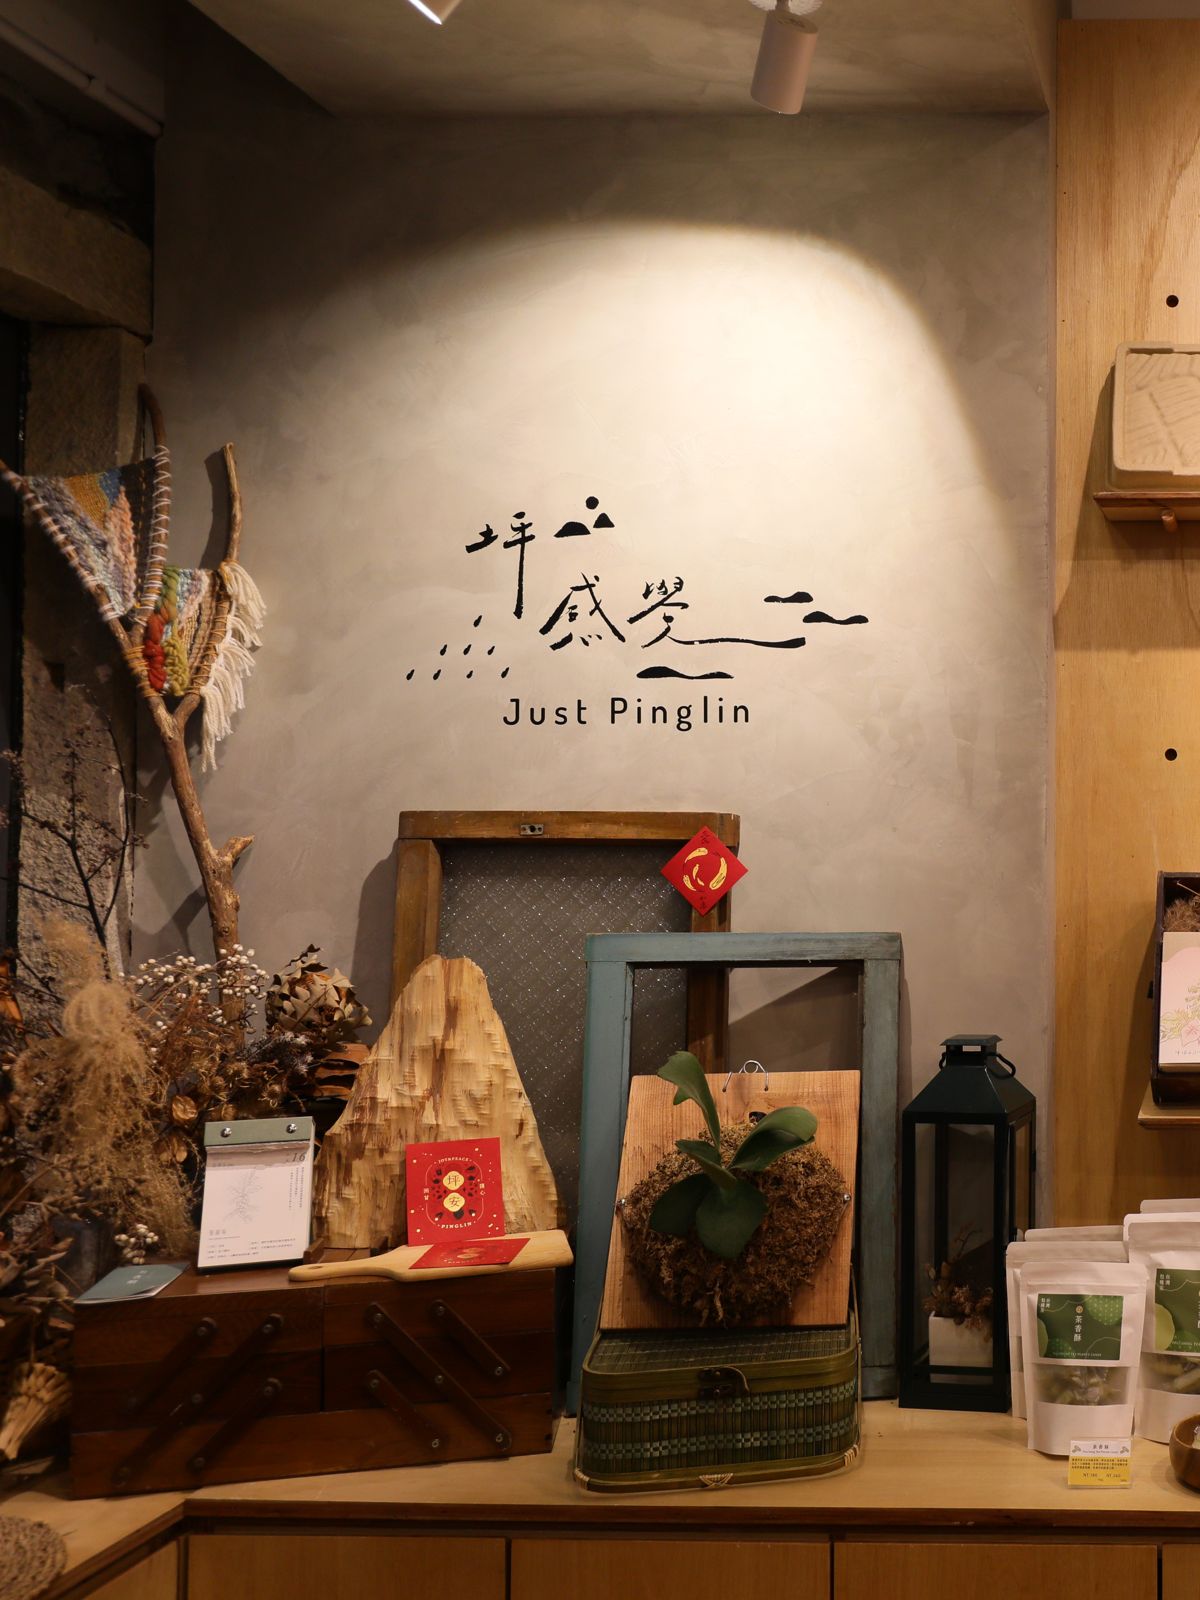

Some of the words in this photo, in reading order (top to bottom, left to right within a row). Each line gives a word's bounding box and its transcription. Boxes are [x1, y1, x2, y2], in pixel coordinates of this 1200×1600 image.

[503, 698, 588, 726] Just
[610, 696, 750, 732] Pinglin
[441, 1221, 473, 1229] PINGLIN
[1074, 1315, 1082, 1342] 茶香酥
